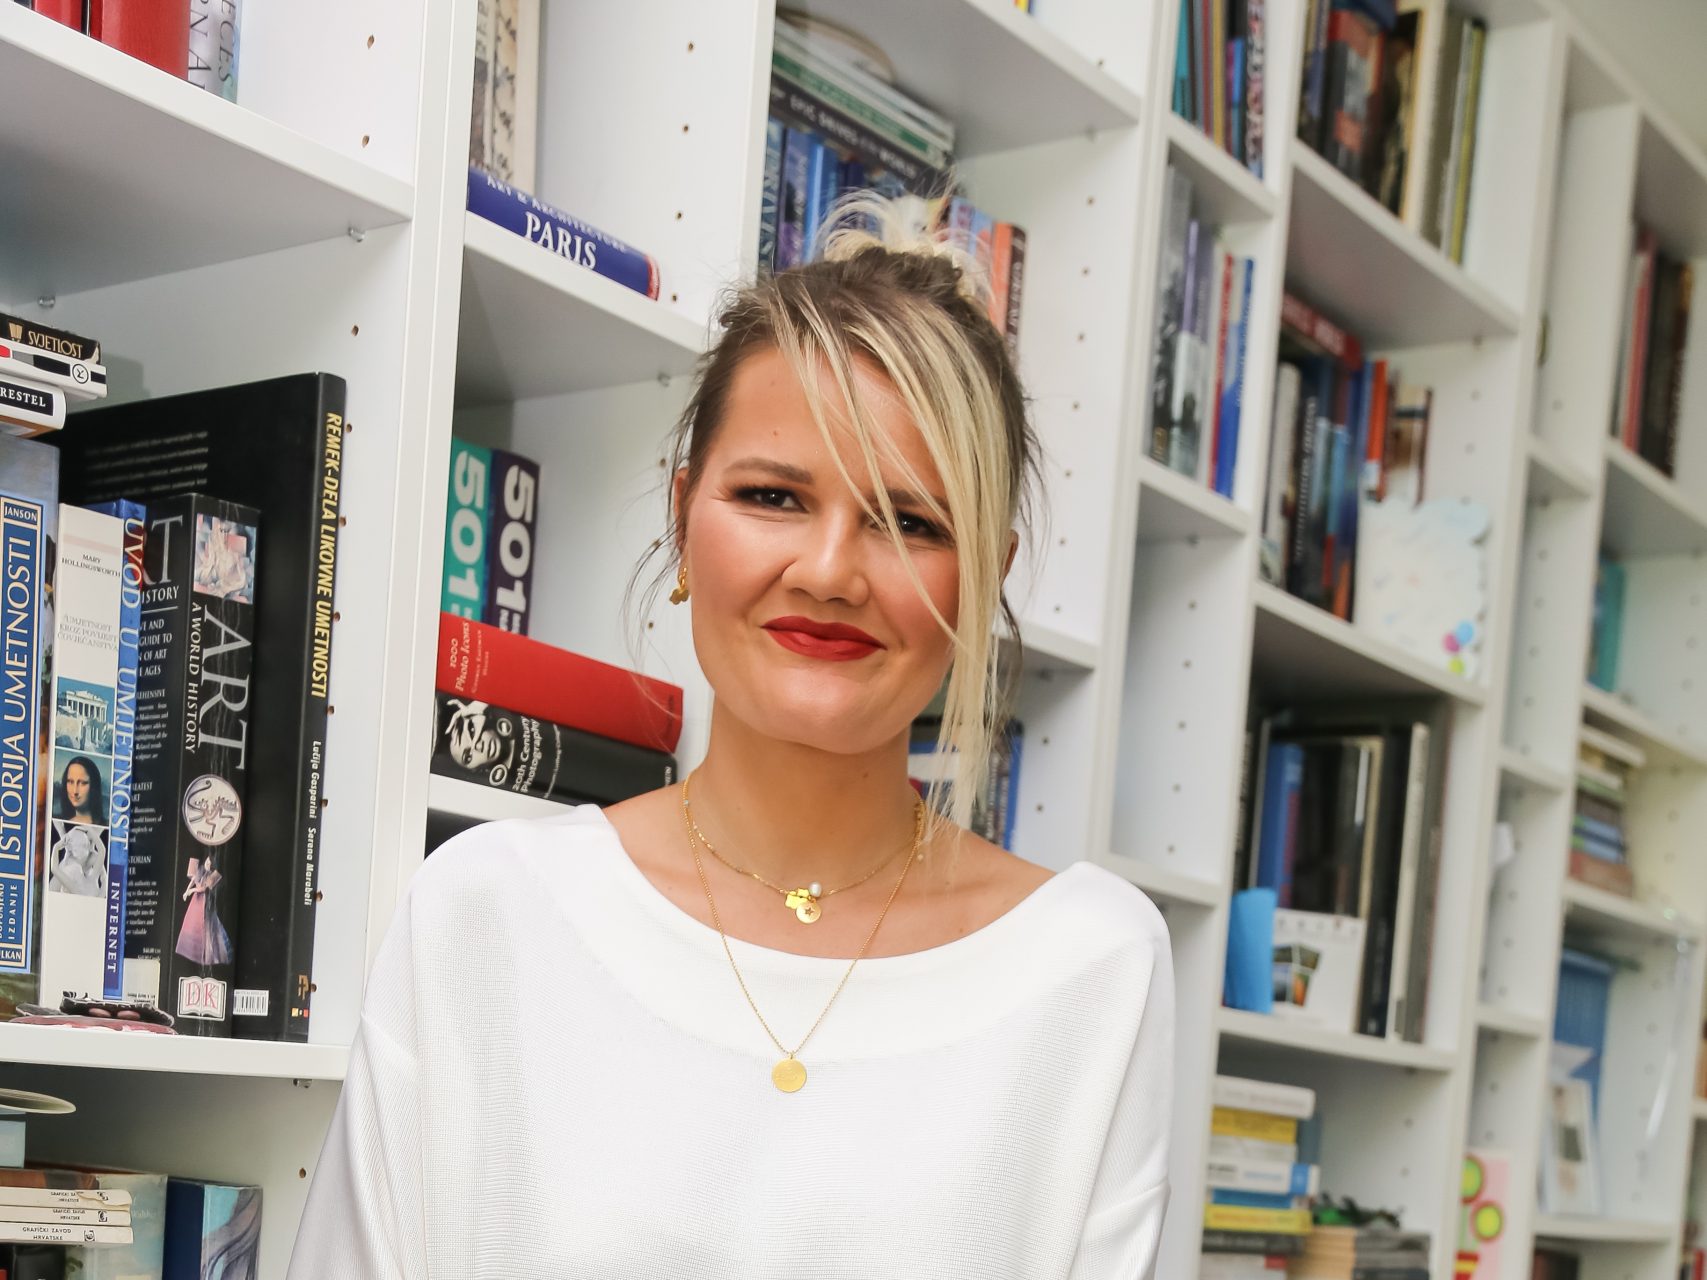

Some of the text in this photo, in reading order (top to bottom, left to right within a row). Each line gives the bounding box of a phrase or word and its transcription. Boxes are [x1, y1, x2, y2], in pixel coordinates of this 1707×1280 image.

[523, 210, 598, 270] PARIS
[28, 330, 83, 358] SVJETLOST
[0, 386, 46, 407] RESTEL
[4, 505, 37, 522] JANSON
[447, 450, 487, 603] 501
[495, 464, 536, 617] 501
[311, 412, 343, 698] REMEK-DELA LIKOVNE UMETNOSTI
[141, 585, 179, 604] ISTORY
[0, 537, 31, 861] ISTORIJA UMETNOSTI
[110, 517, 145, 850] UVOD U UMJETNOST
[184, 602, 202, 754] A WORLD HISTORY
[198, 604, 252, 770] ART
[8, 884, 18, 940] IZDANJE
[107, 882, 120, 973] INTERNET
[1, 949, 21, 960] LKAN
[185, 983, 218, 1009] DK
